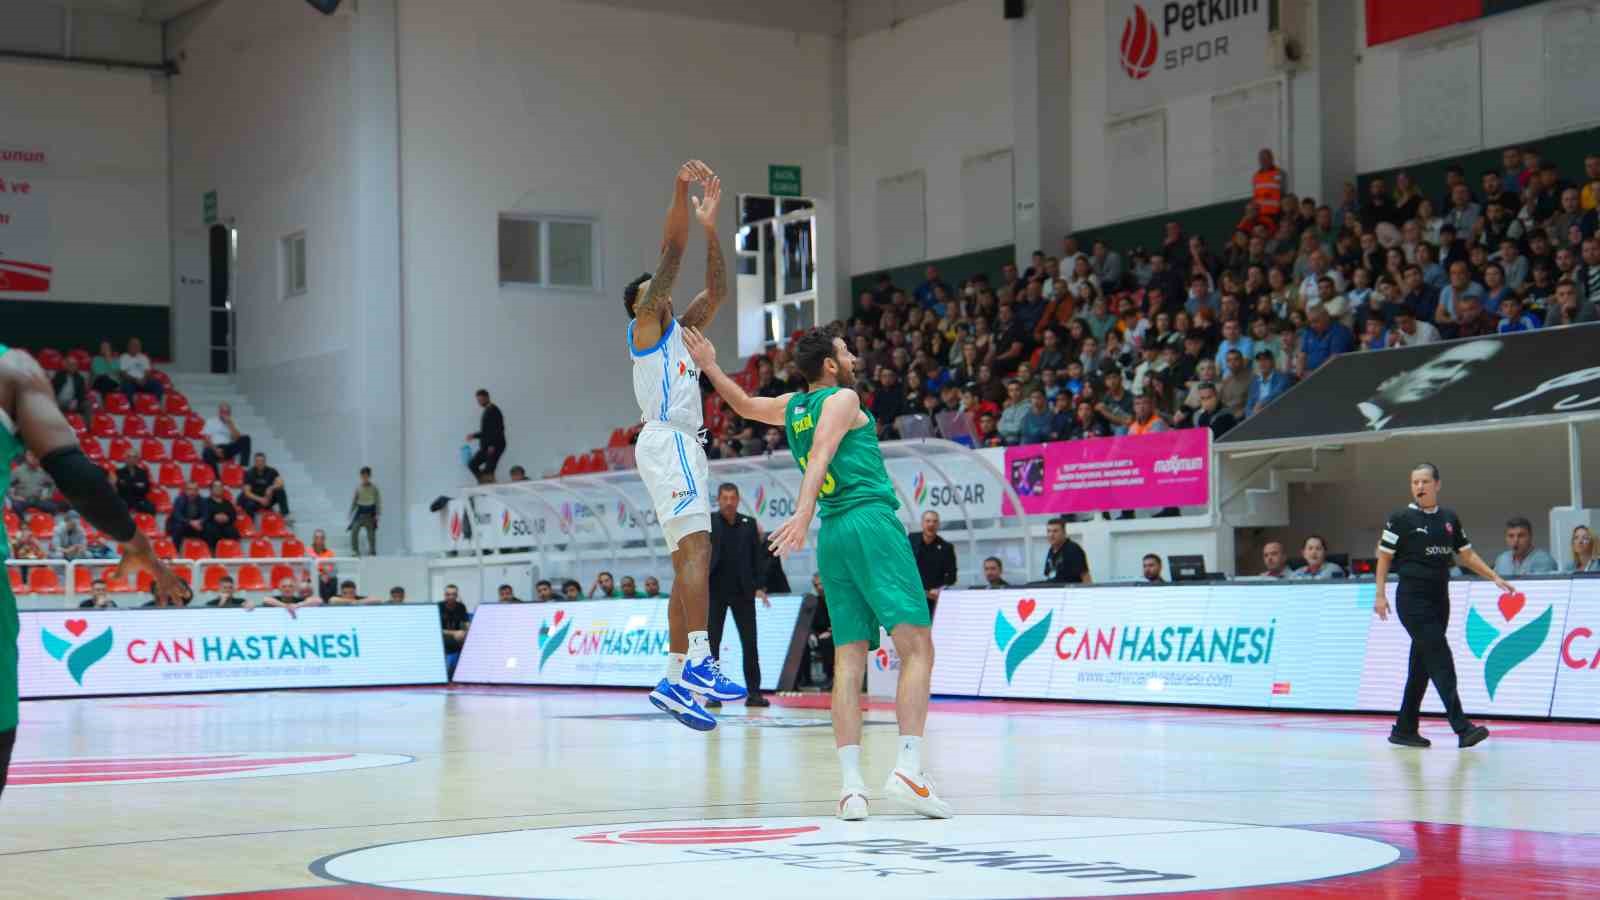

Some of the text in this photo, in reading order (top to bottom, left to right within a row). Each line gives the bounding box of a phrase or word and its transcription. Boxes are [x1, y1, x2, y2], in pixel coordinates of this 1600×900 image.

[1163, 0, 1259, 37] Petkim
[1163, 35, 1229, 70] SPOR
[769, 497, 796, 517] SOC
[930, 484, 985, 506] SOCAR
[127, 627, 360, 665] CAN HASTANESİ
[567, 628, 669, 657] CAN HASTAN
[1056, 618, 1276, 665] CAN HASTANESİ
[1562, 627, 1600, 670] C
